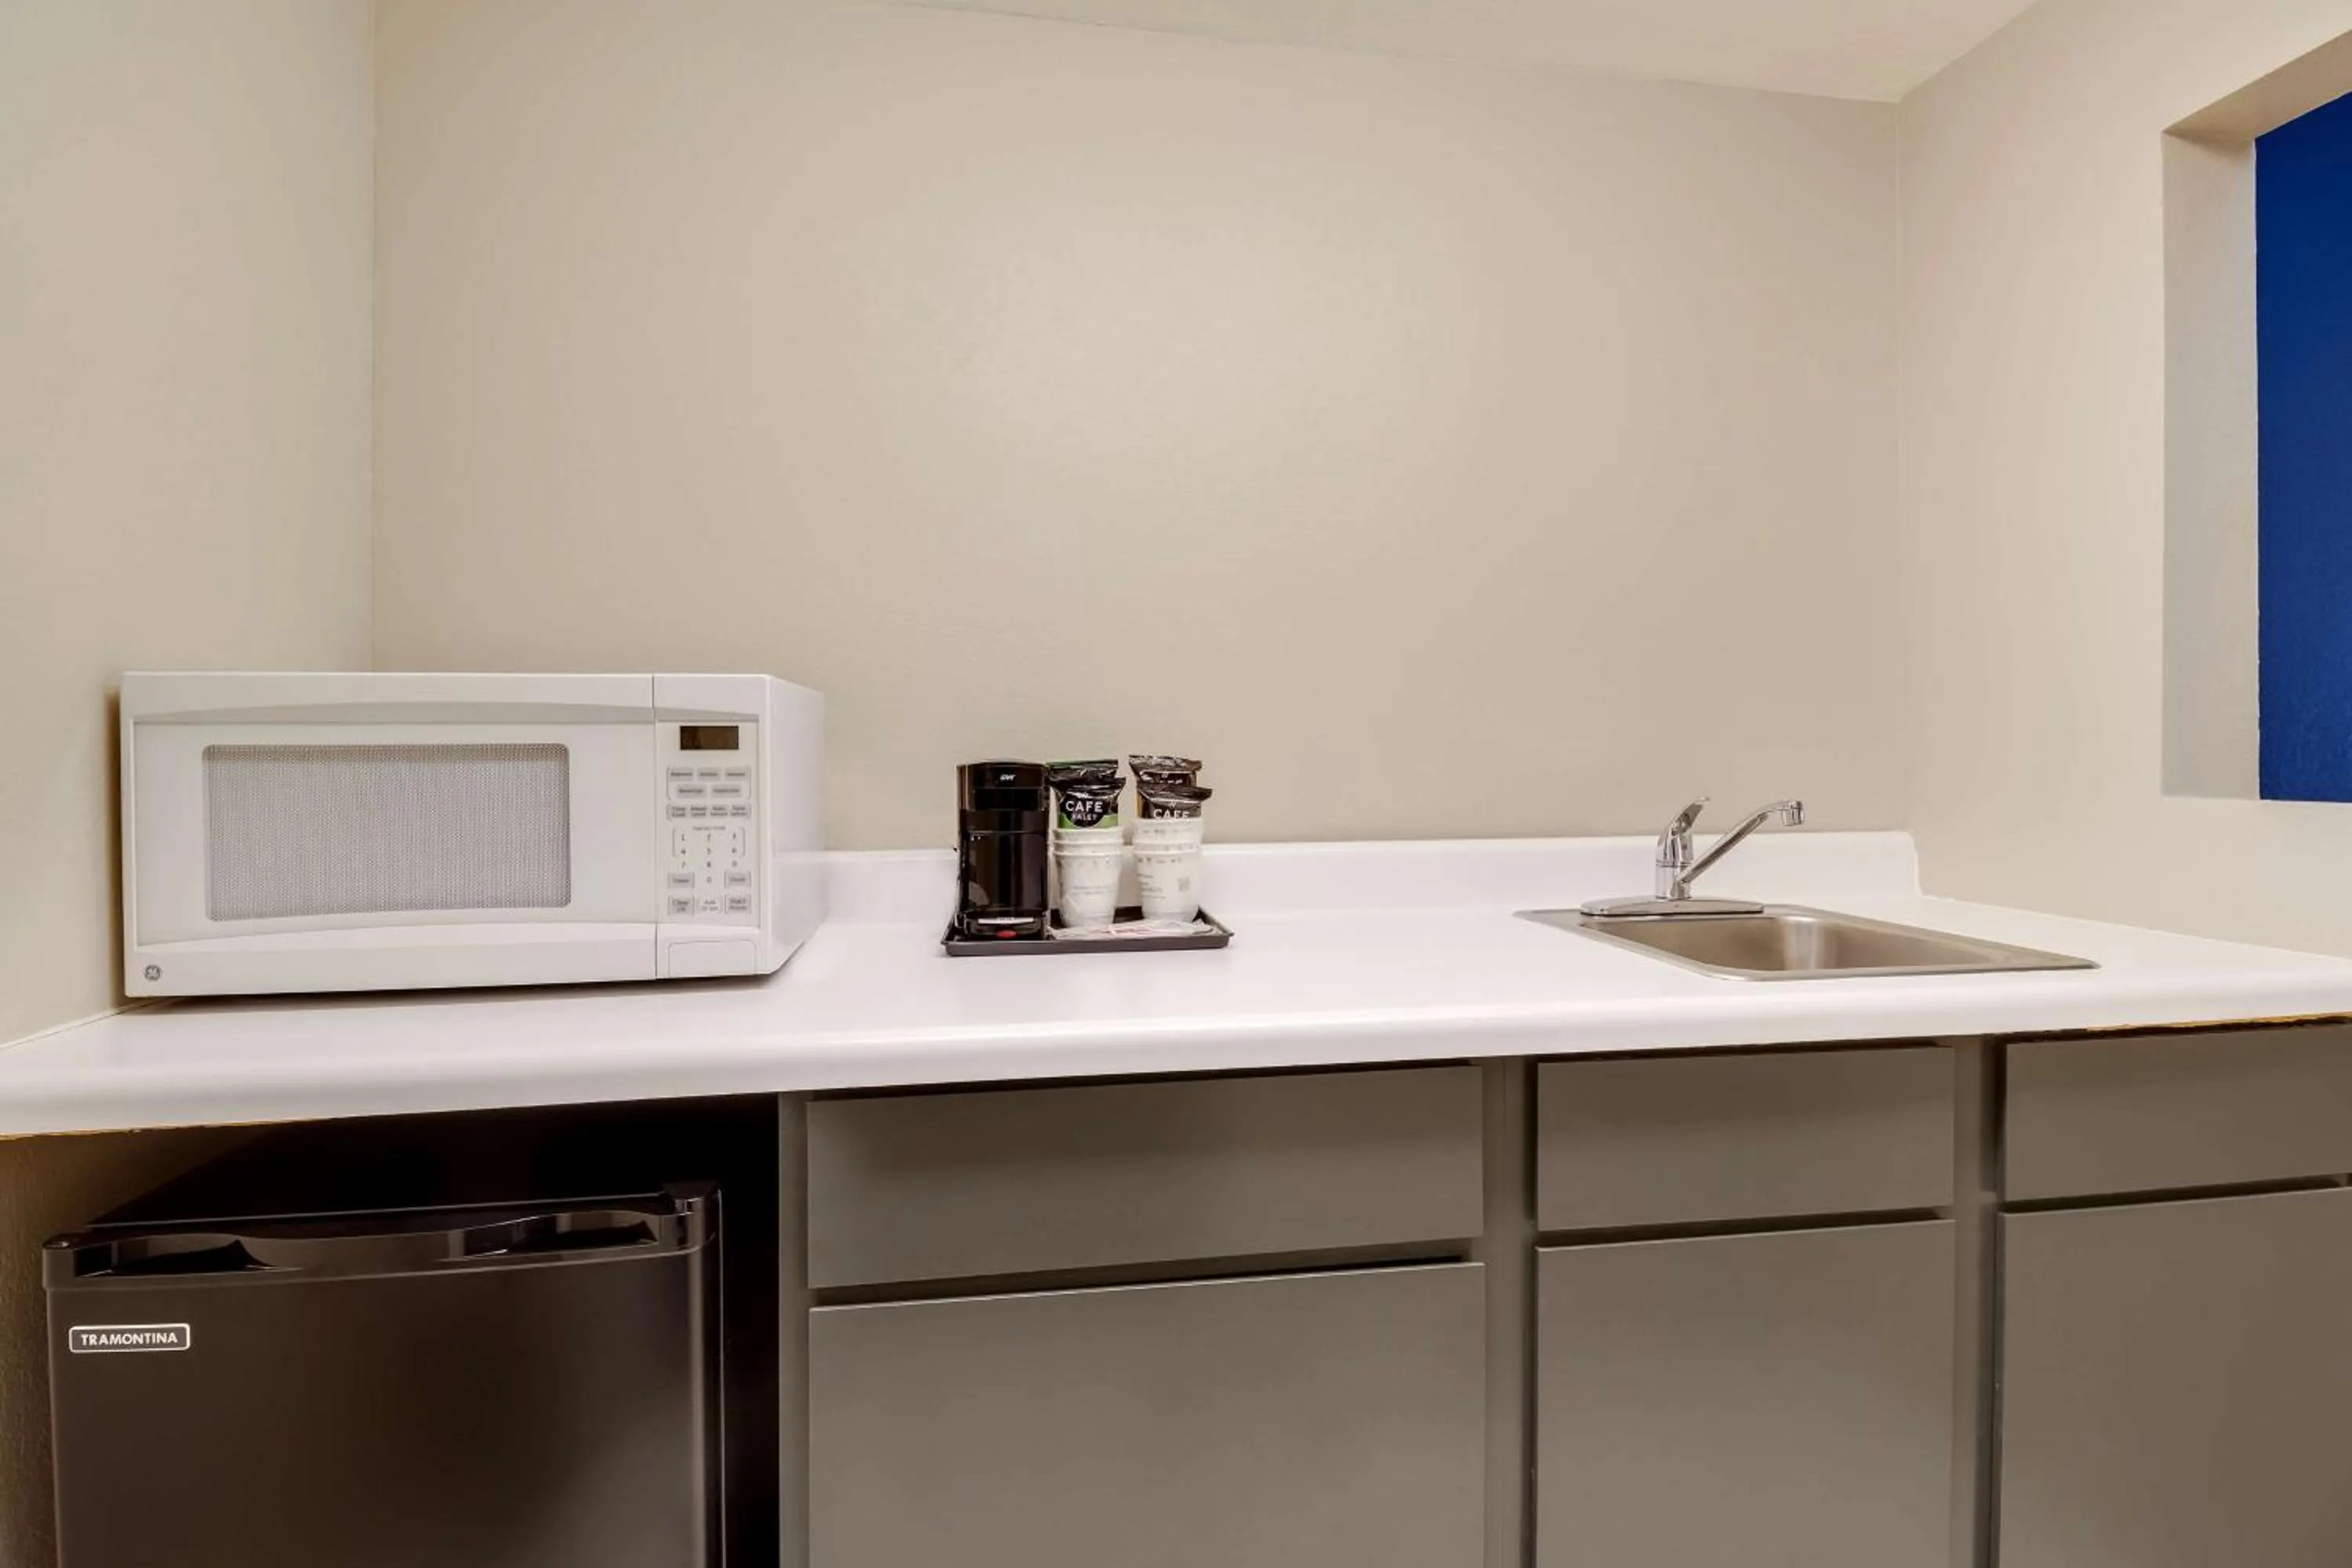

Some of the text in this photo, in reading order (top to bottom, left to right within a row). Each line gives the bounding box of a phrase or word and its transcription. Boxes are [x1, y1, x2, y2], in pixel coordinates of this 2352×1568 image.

[1065, 800, 1103, 813] CAFE
[1153, 808, 1189, 818] CAFE
[81, 1332, 178, 1346] TRAMONTINA
